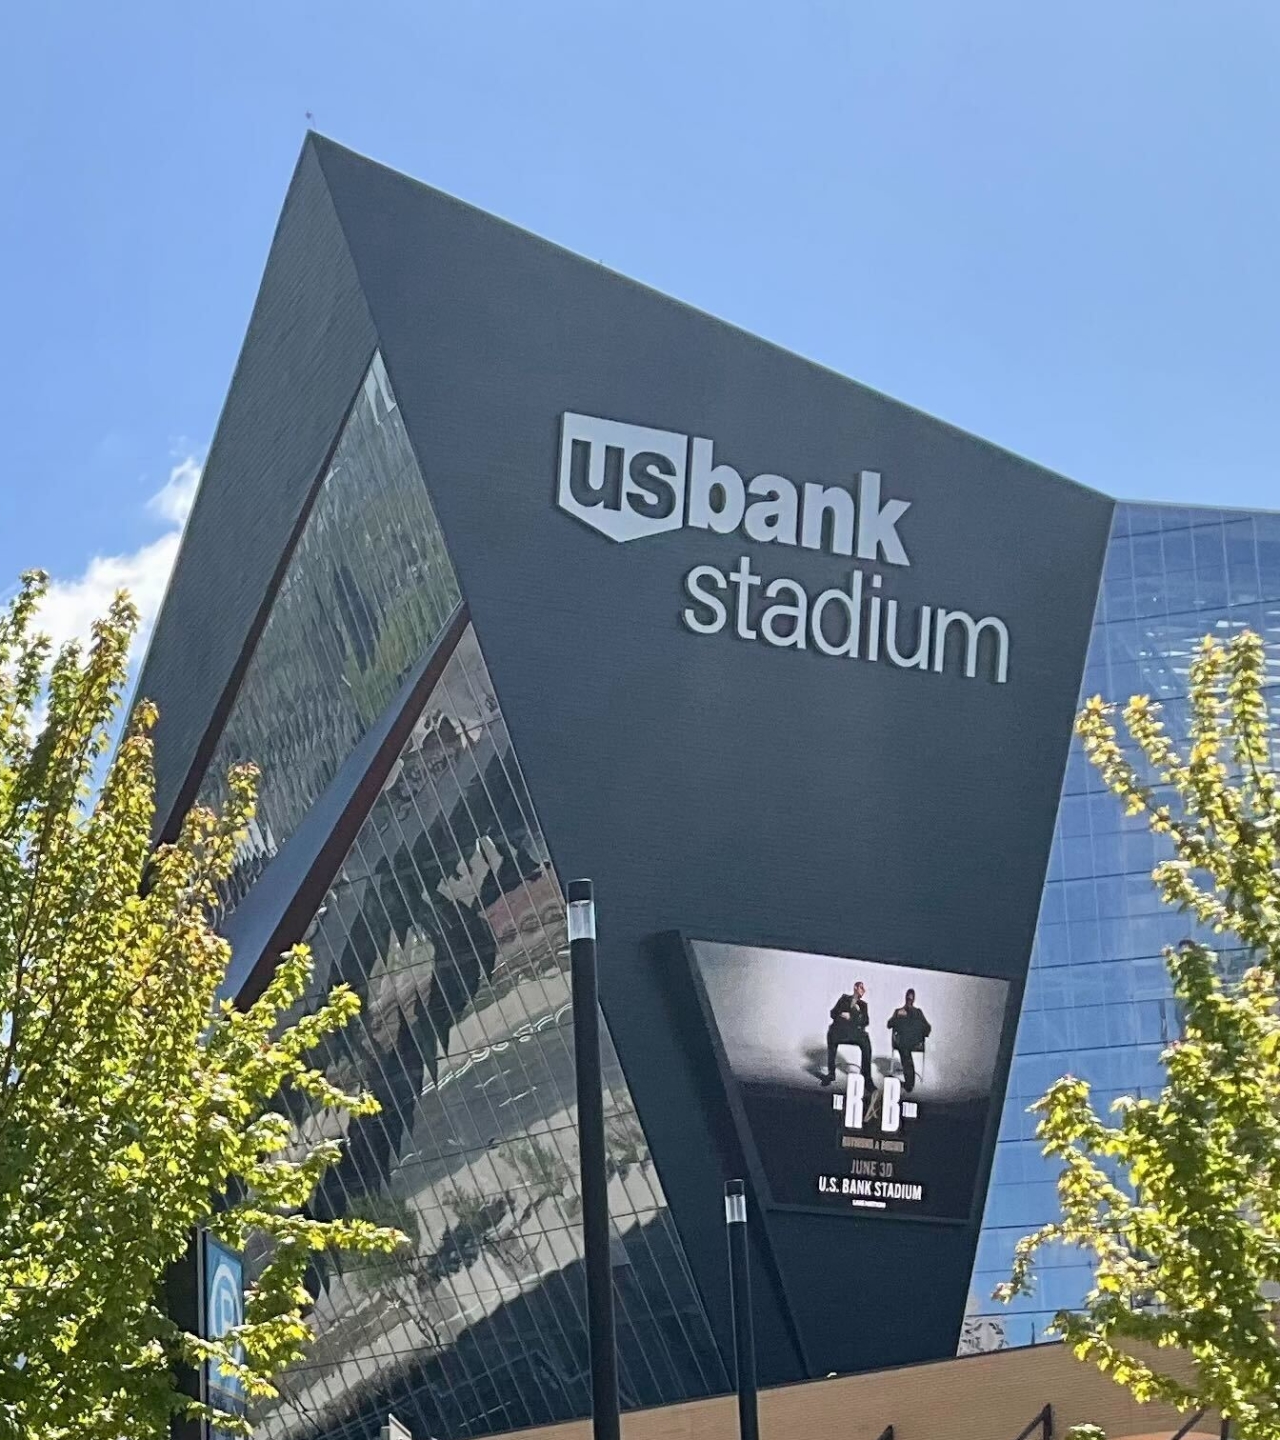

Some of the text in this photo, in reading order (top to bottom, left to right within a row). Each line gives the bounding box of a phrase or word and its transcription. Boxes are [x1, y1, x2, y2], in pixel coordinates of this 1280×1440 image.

[681, 555, 1009, 684] stadium
[850, 1159, 893, 1178] JUNE 30
[818, 1175, 922, 1200] U.S. BANK STADIUM
